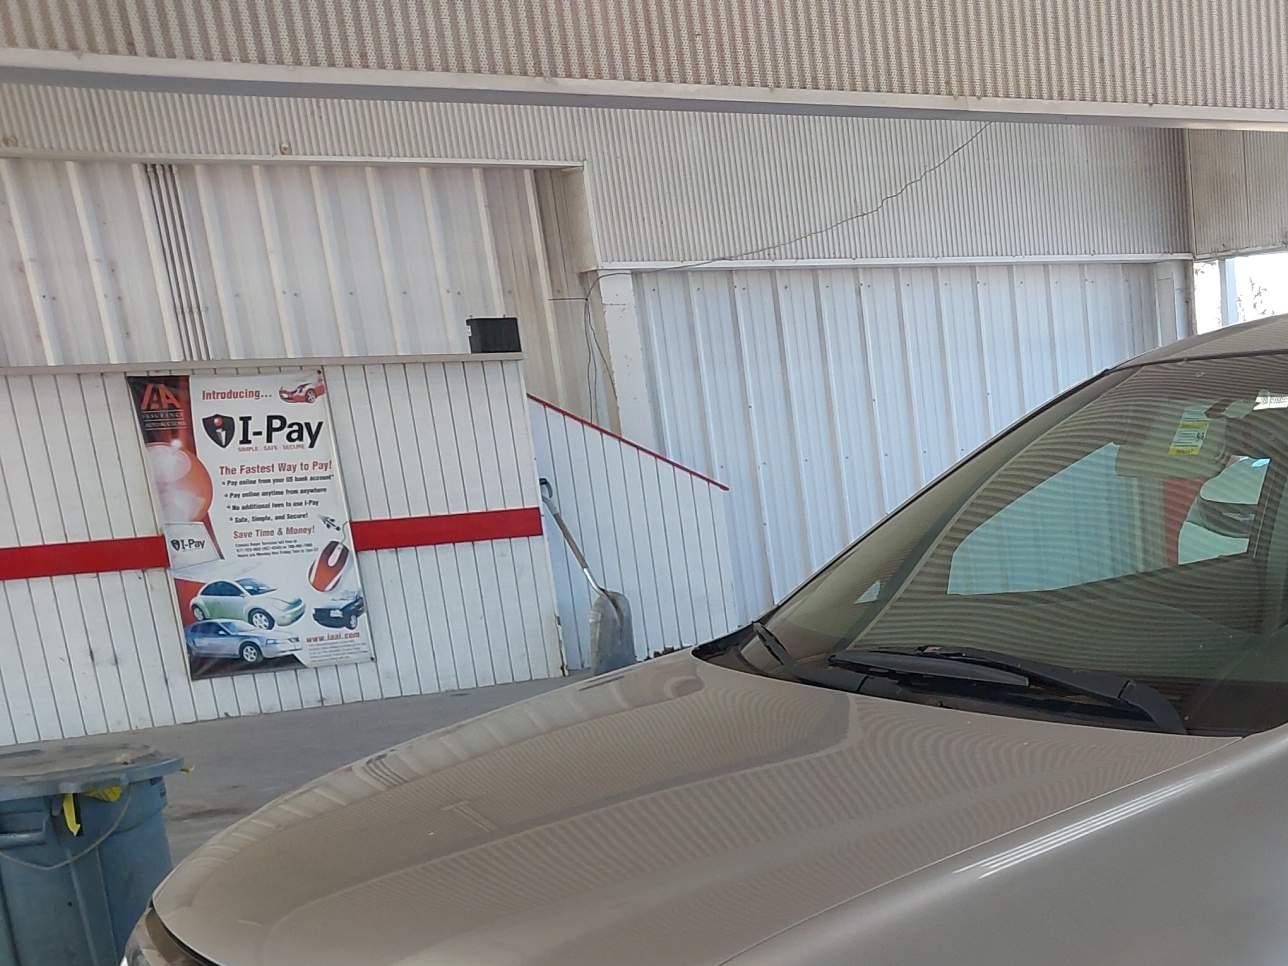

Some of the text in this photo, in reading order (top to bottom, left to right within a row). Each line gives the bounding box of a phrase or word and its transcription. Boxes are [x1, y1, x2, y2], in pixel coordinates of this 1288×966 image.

[202, 389, 273, 401] Introducing...
[239, 415, 324, 449] I-Pay
[219, 460, 332, 475] The Fastest Way to Pay!
[233, 525, 315, 539] Save Time & Money!
[181, 538, 205, 550] I-Pay
